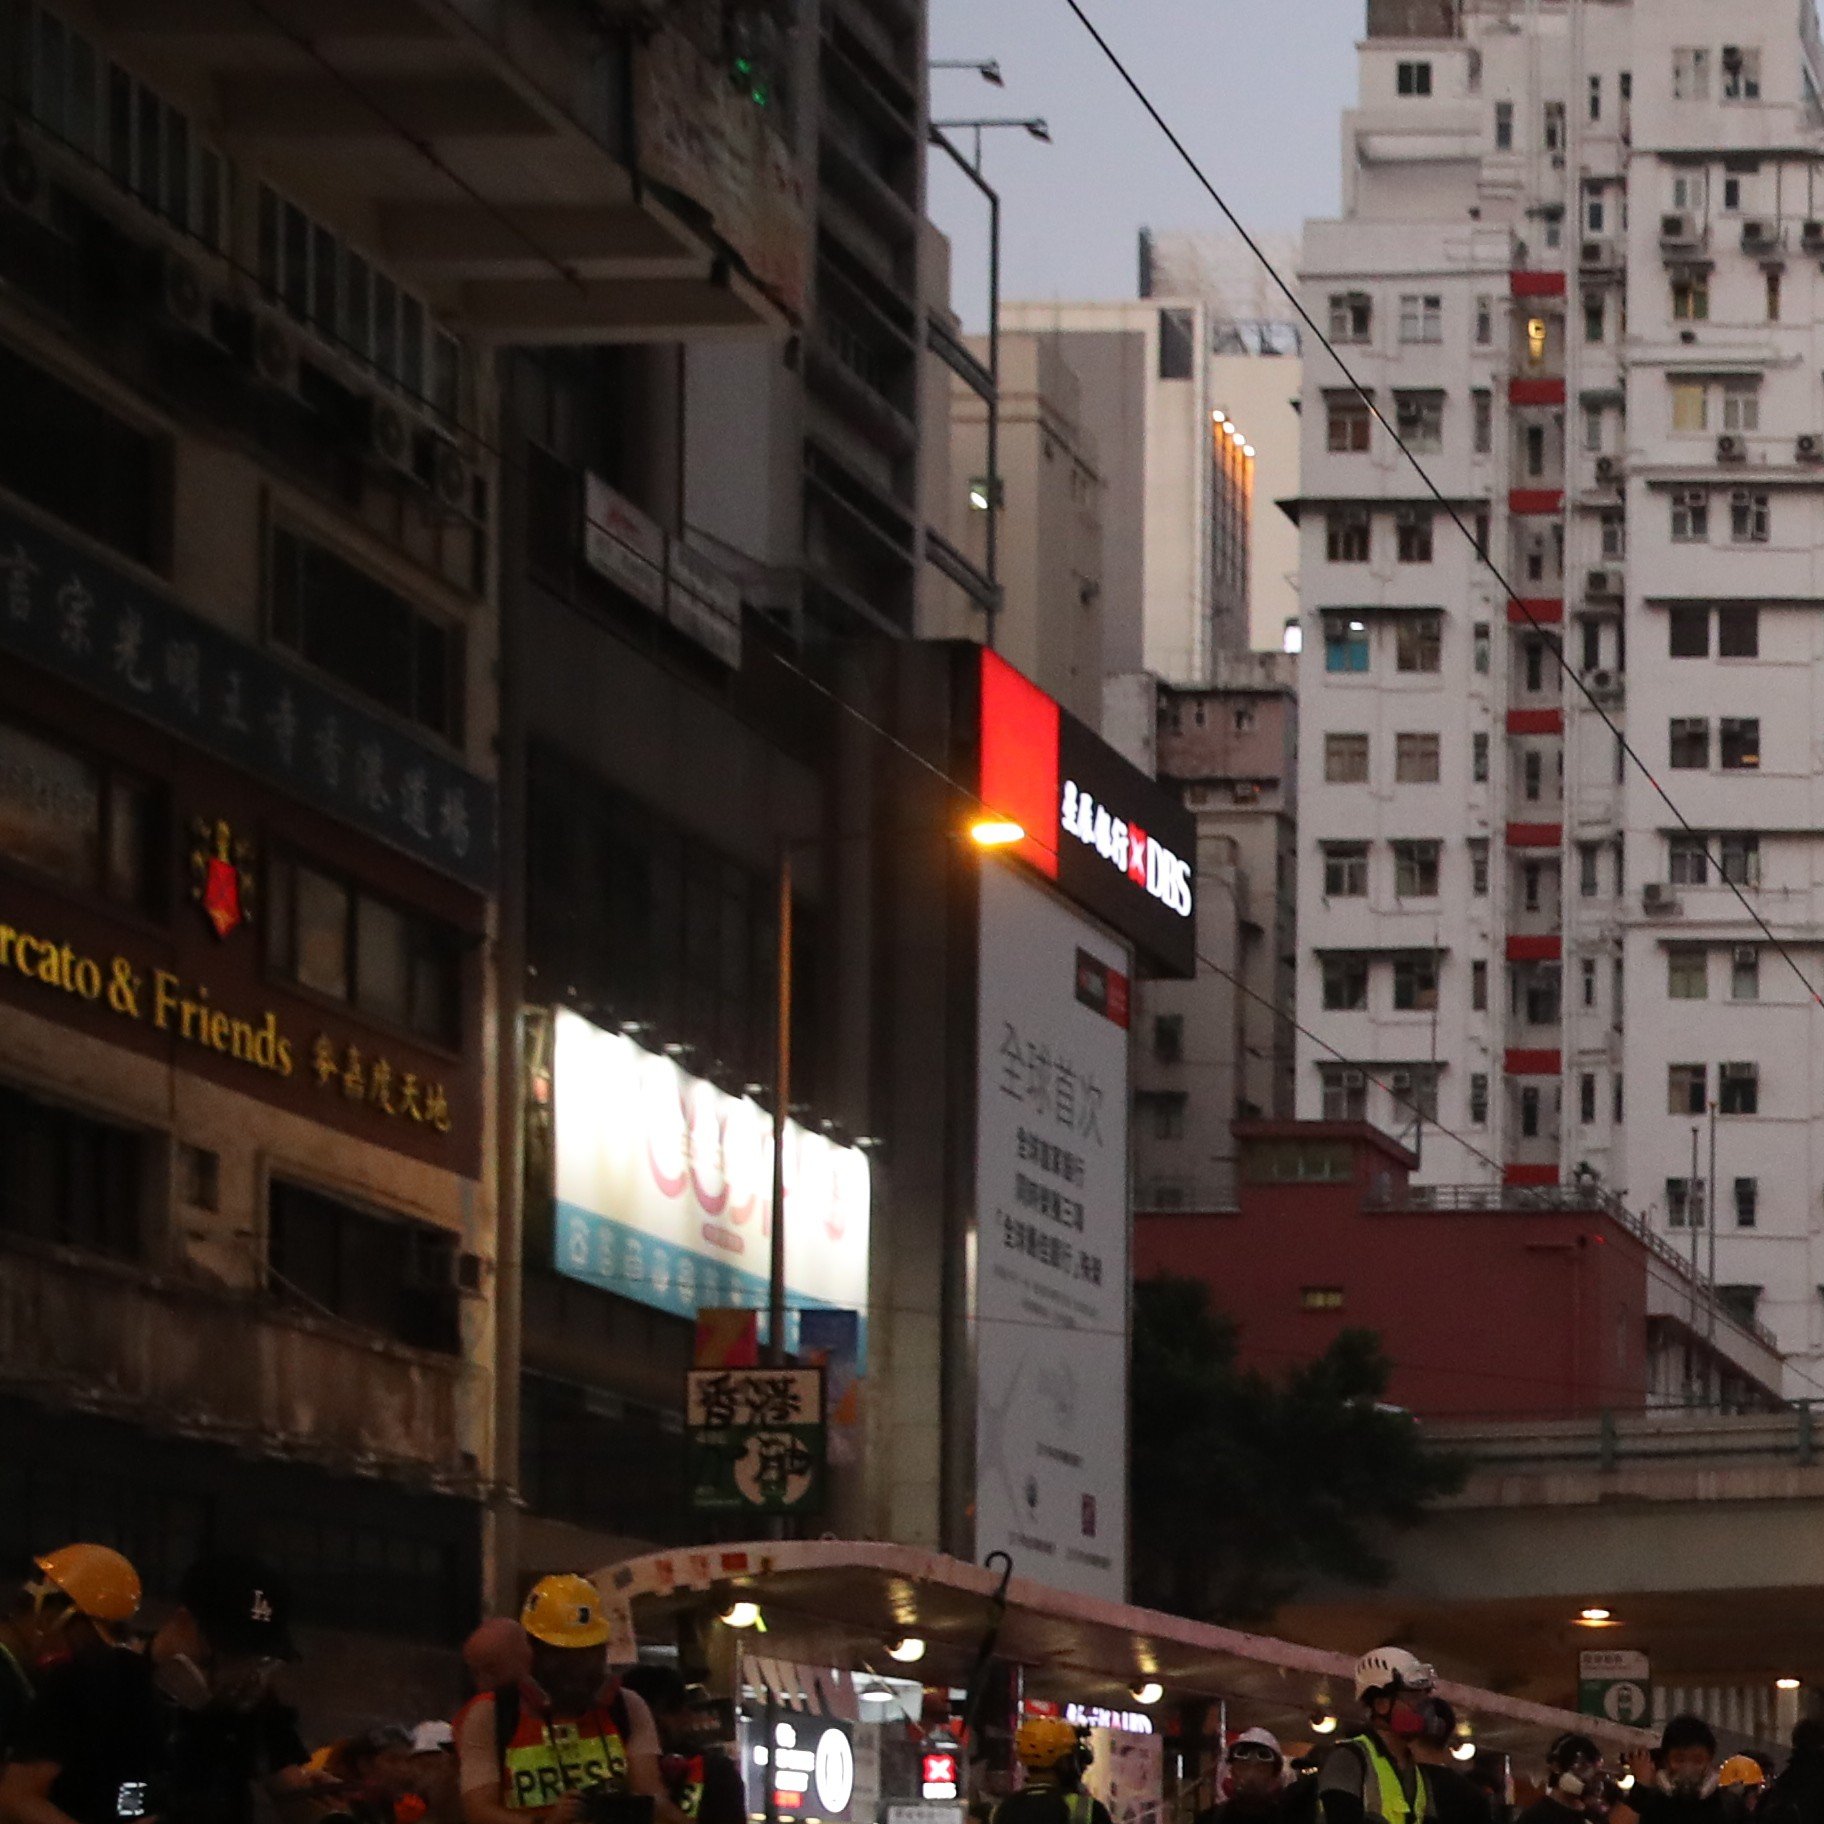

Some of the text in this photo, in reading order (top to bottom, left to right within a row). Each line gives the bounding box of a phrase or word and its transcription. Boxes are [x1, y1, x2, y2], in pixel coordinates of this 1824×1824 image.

[1146, 836, 1192, 916] DBS
[107, 956, 141, 1019] &
[152, 968, 294, 1076] Friends
